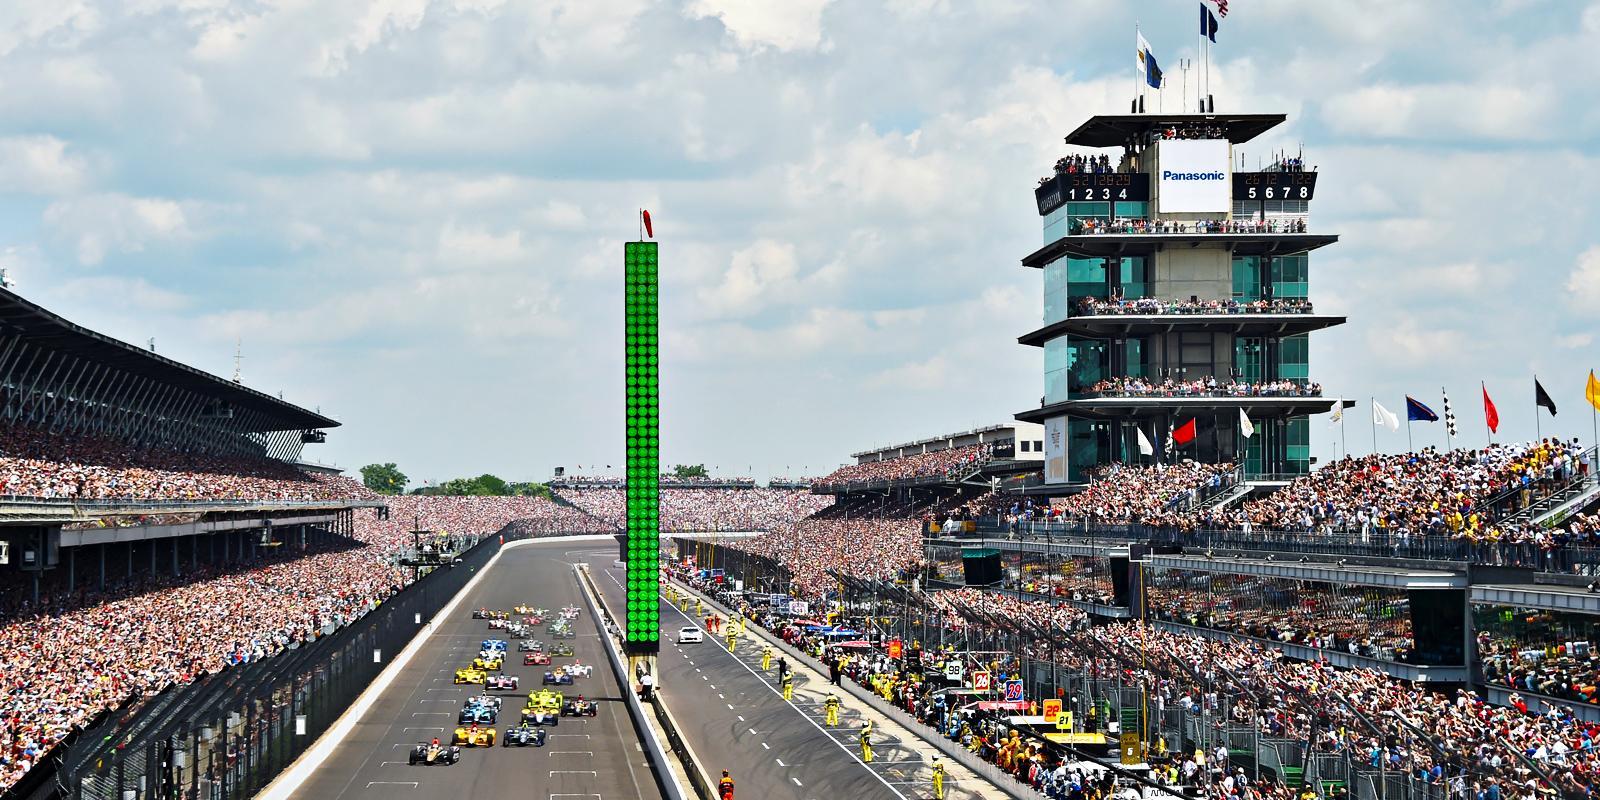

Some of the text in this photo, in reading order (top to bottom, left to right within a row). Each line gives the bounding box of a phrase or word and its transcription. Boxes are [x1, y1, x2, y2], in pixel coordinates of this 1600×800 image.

[1163, 170, 1225, 181] Panasonic
[1069, 188, 1127, 200] 1 2 3 4
[1249, 187, 1308, 199] 5 6 7 8
[976, 675, 988, 688] 26
[1008, 684, 1022, 698] 29
[1058, 716, 1069, 725] 21
